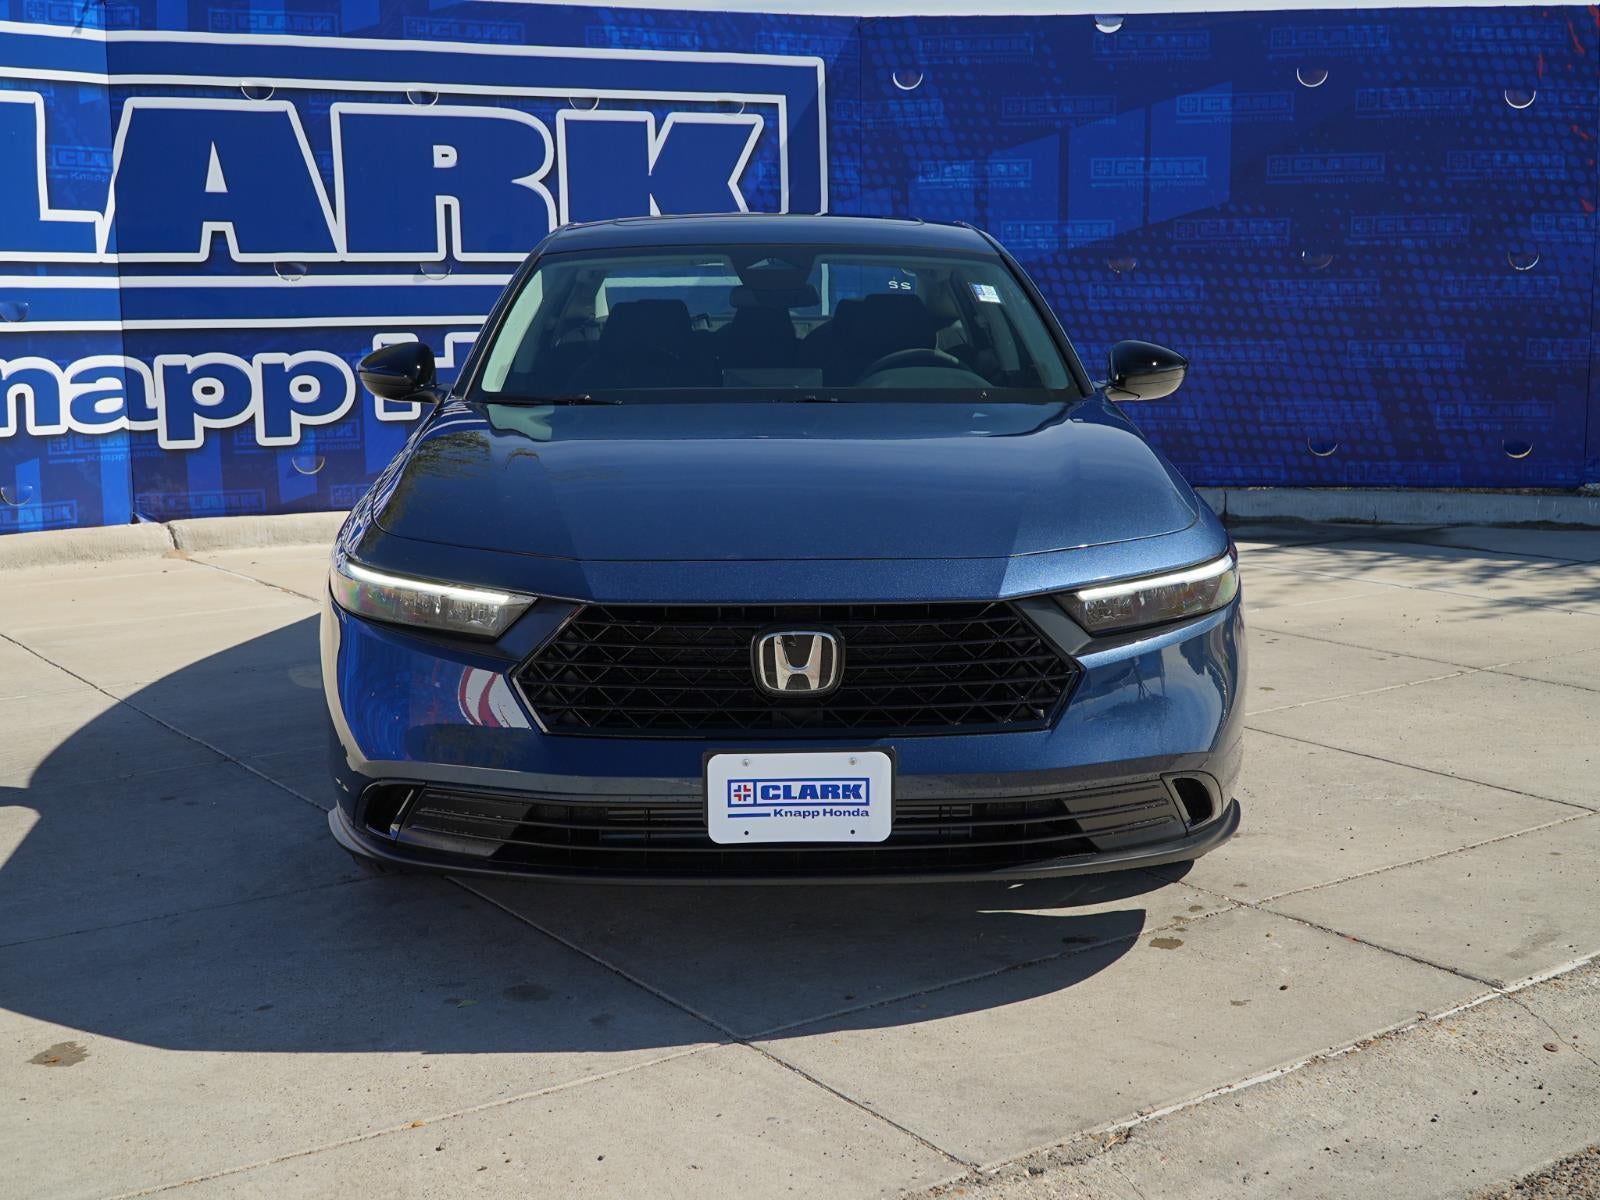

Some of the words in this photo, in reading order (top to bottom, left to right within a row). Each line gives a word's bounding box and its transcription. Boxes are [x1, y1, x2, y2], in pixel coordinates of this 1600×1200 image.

[760, 784, 863, 801] CLARK
[773, 808, 820, 819] Knapp
[823, 808, 869, 817] Honda
